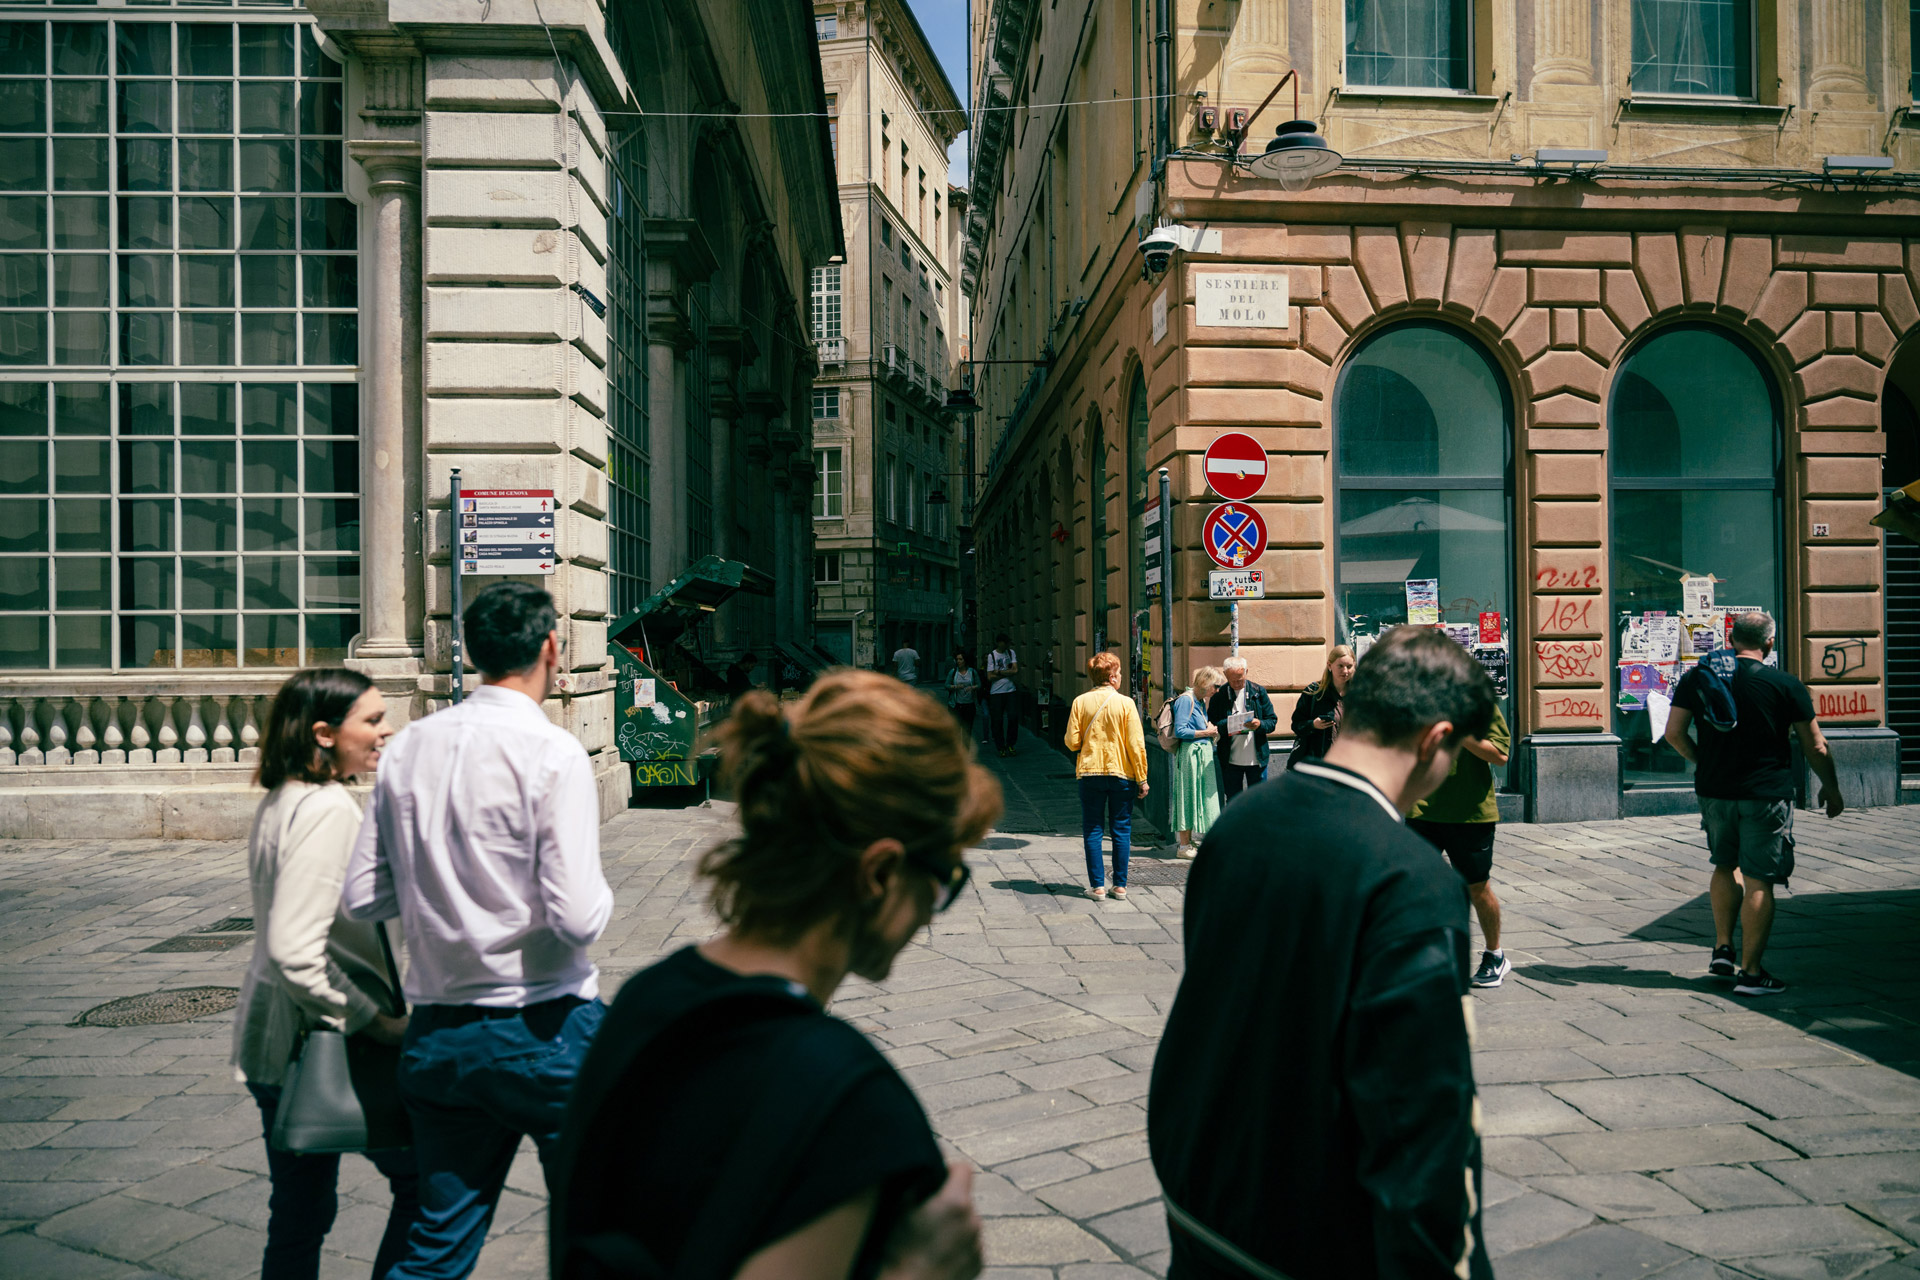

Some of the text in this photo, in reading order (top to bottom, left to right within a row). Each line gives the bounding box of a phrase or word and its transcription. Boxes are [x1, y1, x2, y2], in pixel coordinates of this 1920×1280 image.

[1205, 279, 1279, 290] SESTIERE
[1230, 295, 1255, 304] DEL
[1219, 309, 1266, 321] MOLO
[1540, 597, 1592, 632] 161
